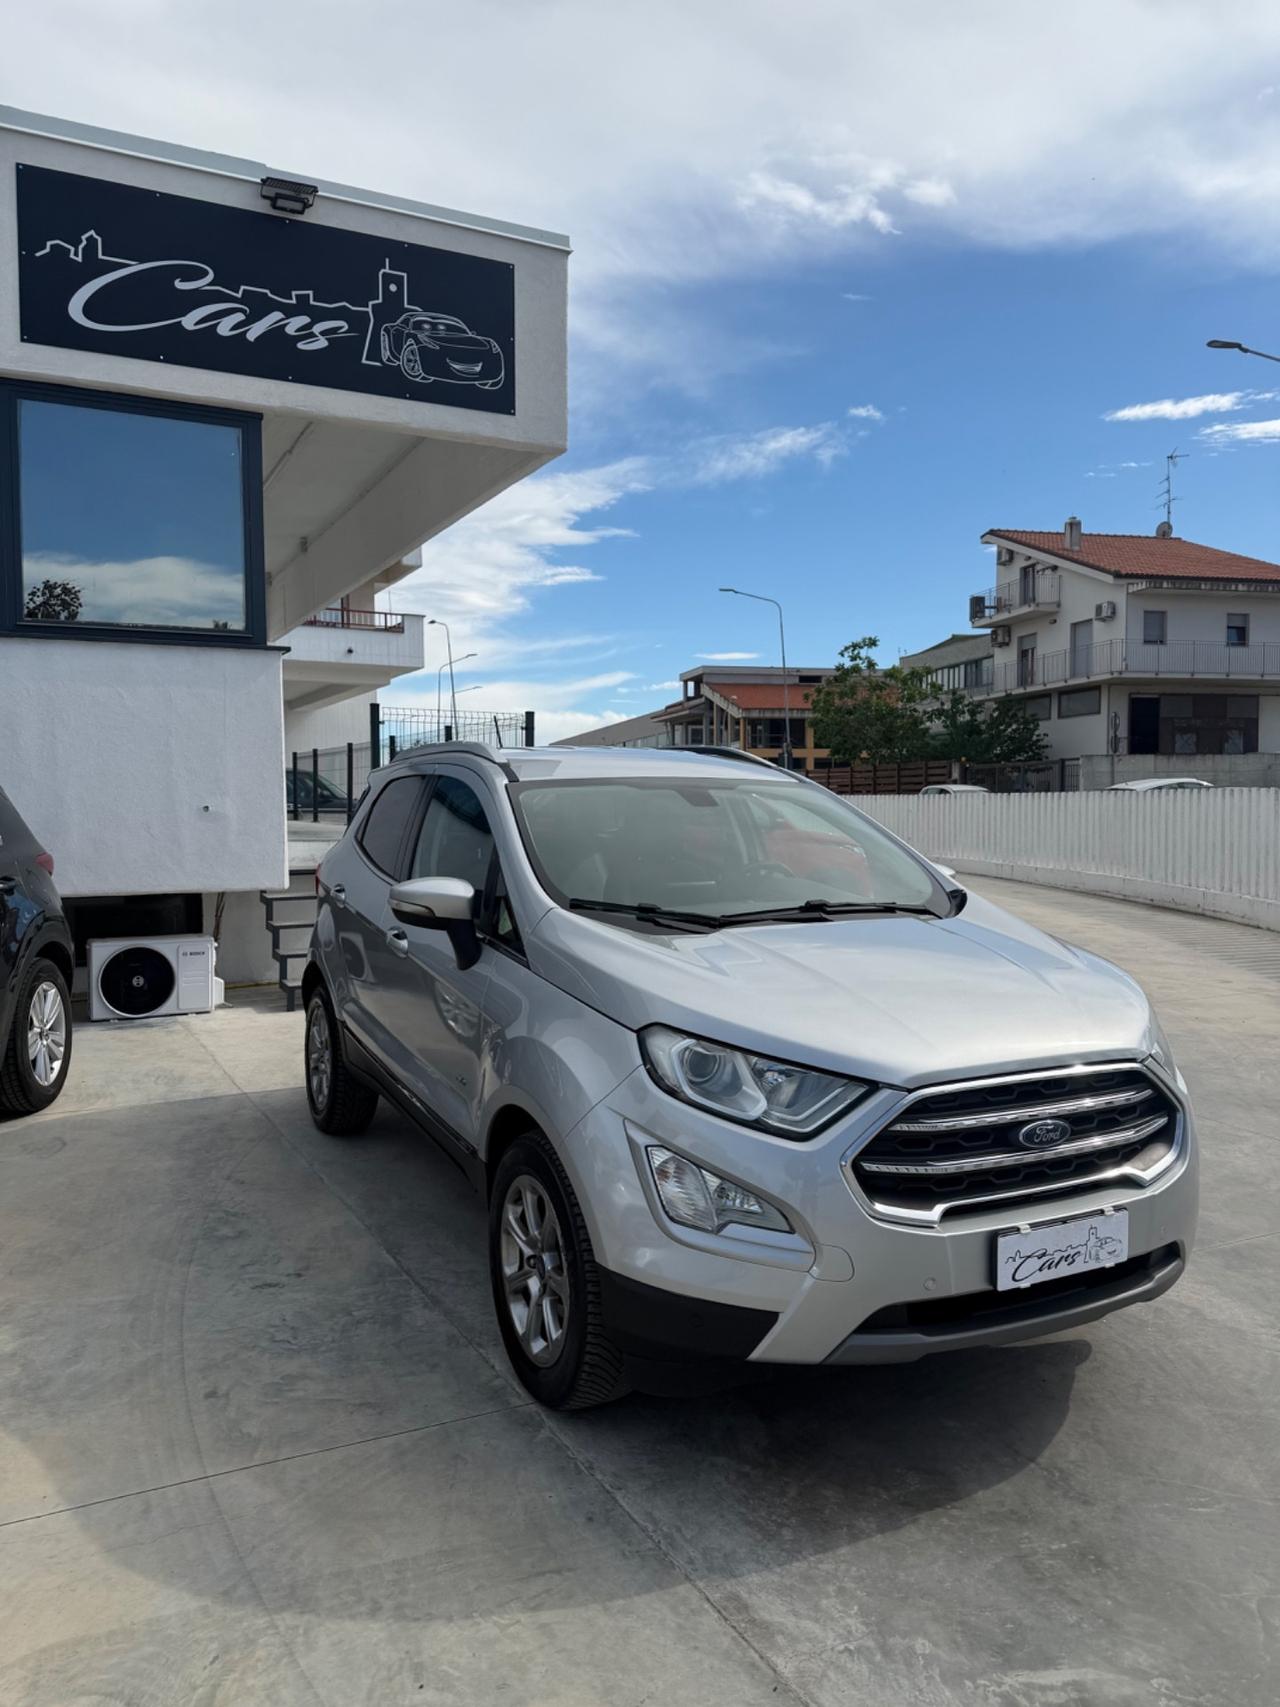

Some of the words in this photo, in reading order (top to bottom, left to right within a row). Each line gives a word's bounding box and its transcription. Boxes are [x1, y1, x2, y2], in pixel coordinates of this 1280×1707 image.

[68, 260, 359, 350] Cars
[1034, 1125, 1061, 1142] Ford
[1012, 1249, 1082, 1282] Cars
